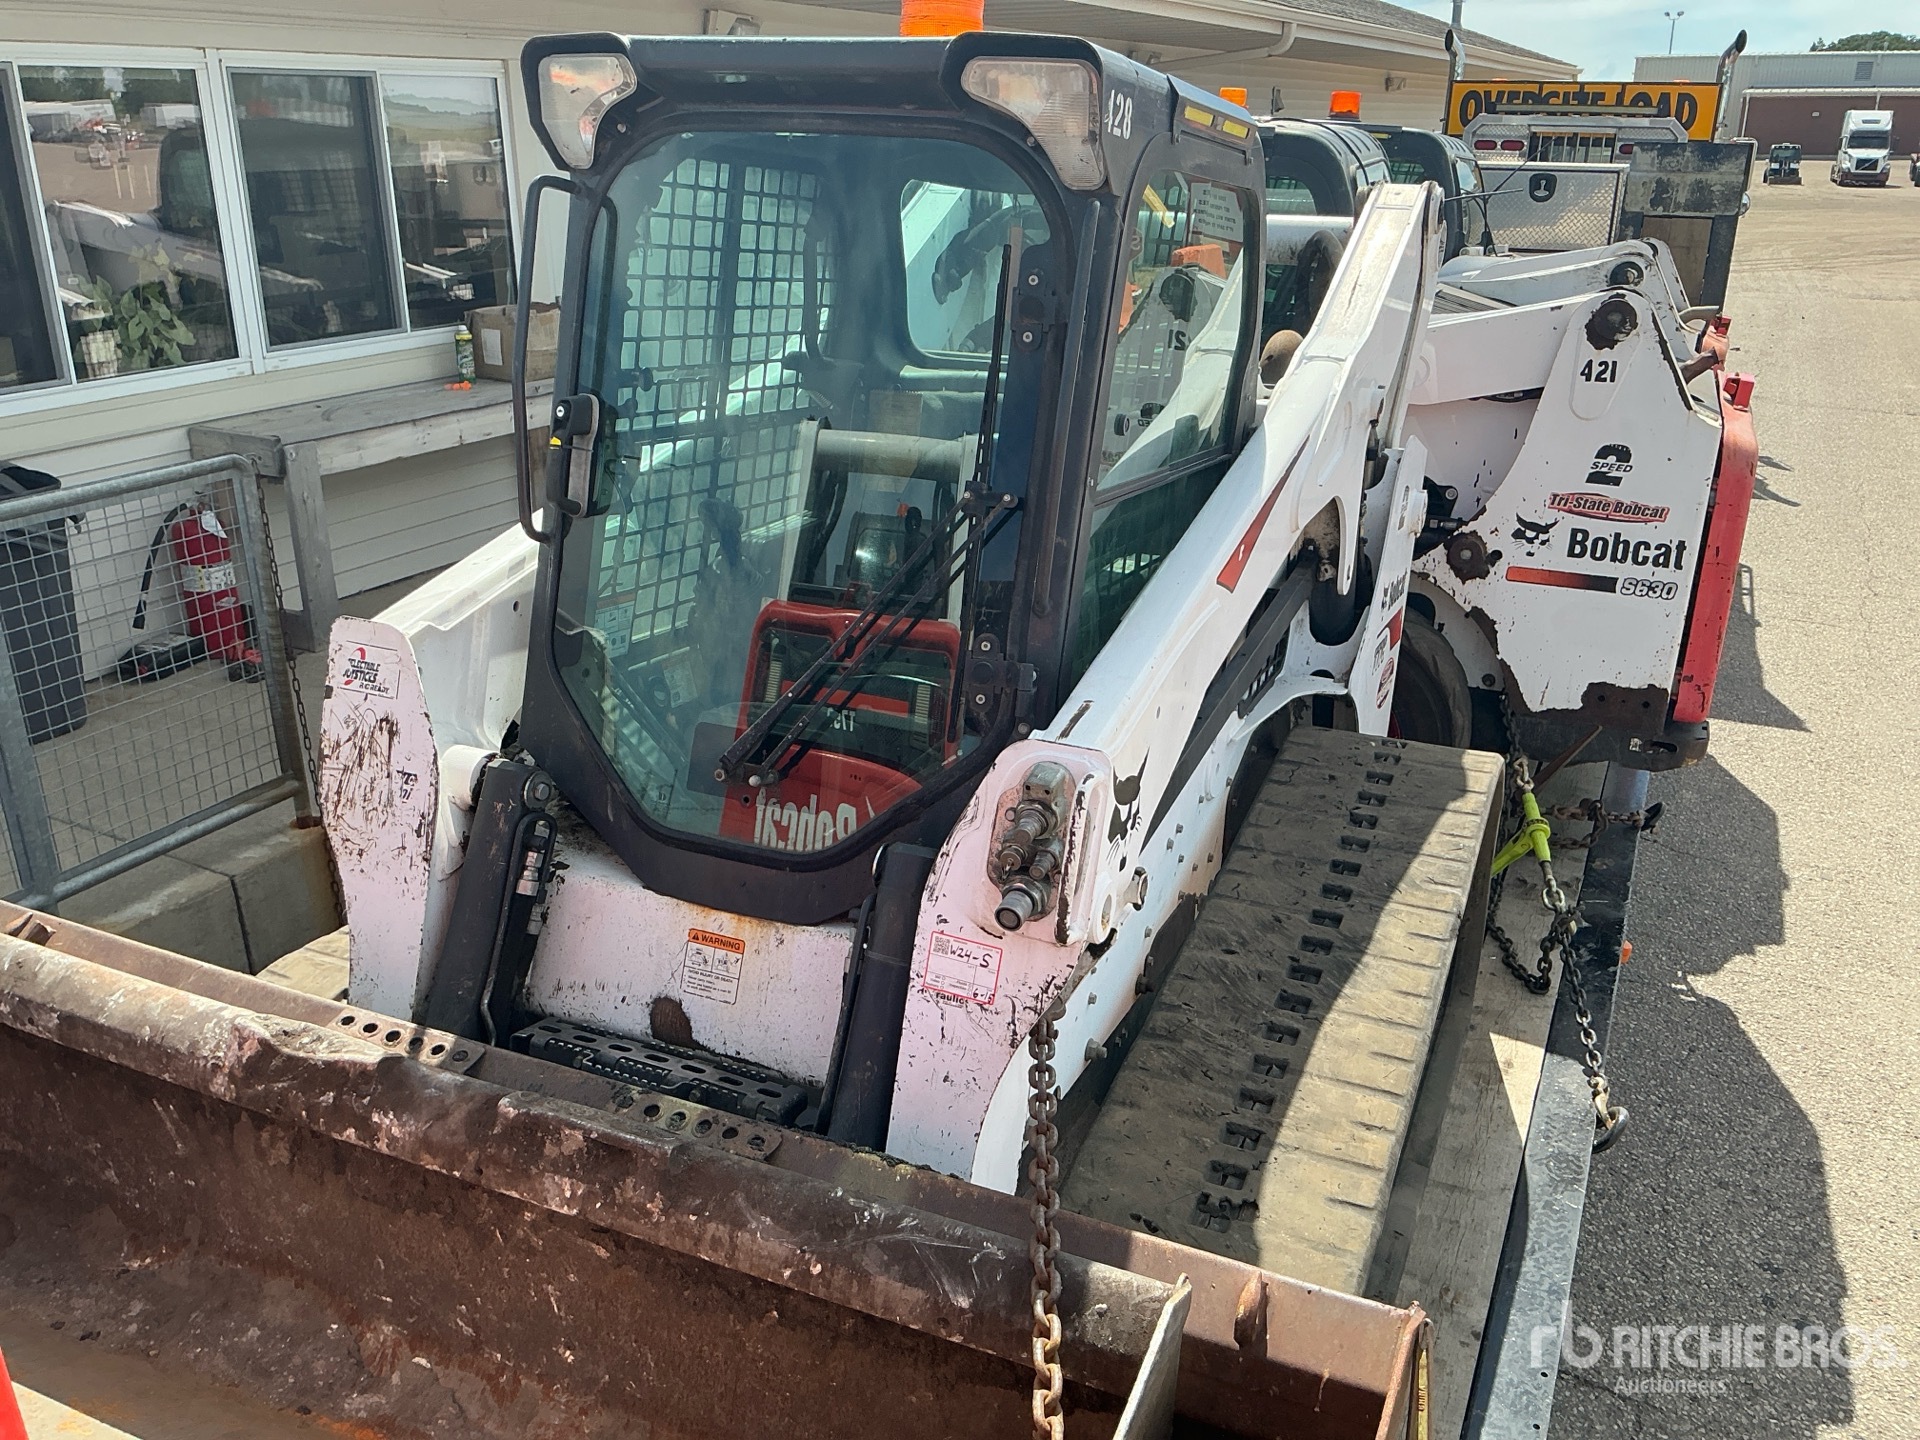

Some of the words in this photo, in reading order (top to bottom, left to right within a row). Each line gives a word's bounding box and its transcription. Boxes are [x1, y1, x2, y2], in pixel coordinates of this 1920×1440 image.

[1579, 358, 1618, 383] 421
[1590, 460, 1634, 474] SPEED
[1550, 492, 1612, 513] Tri-State
[1612, 501, 1668, 520] Bobcat
[1566, 527, 1688, 571] Bobcat
[1619, 577, 1679, 601] S630
[701, 933, 741, 951] WARNING
